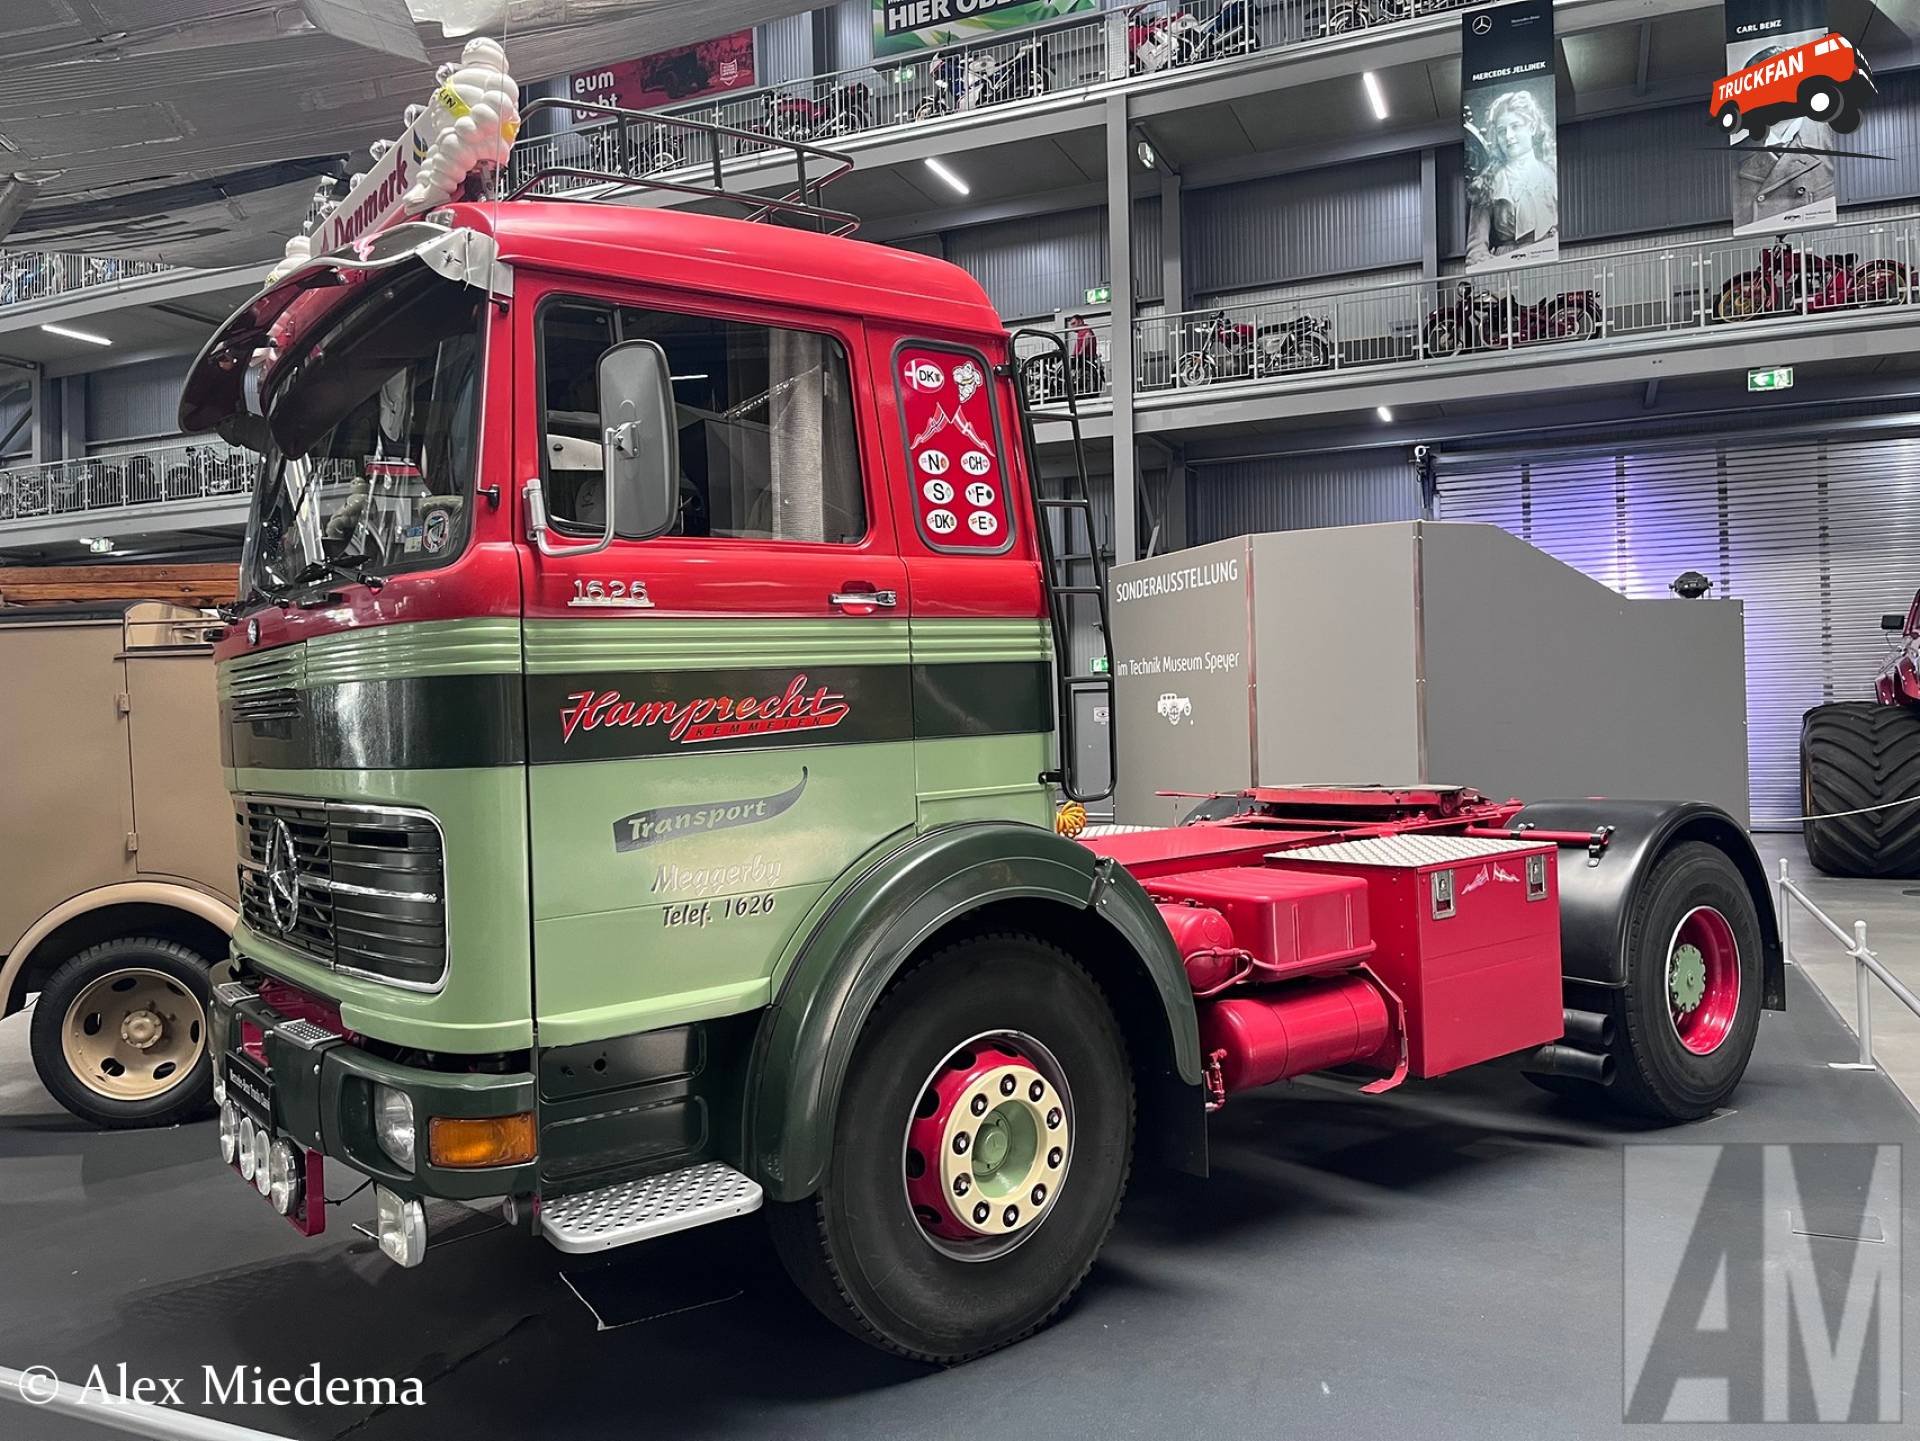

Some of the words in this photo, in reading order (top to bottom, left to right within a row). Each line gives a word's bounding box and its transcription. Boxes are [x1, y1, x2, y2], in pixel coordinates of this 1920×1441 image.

[888, 0, 951, 31] HIER
[1736, 25, 1758, 34] CARL
[1759, 19, 1782, 30] BENZ
[1472, 67, 1511, 81] MERCEDES
[1511, 61, 1546, 74] JELLINEK
[574, 71, 615, 94] eum
[334, 145, 408, 250] Danmark
[918, 370, 935, 382] DK
[928, 454, 940, 471] N
[968, 455, 984, 471] CH
[933, 483, 945, 501] S
[975, 486, 985, 504] F
[934, 514, 951, 529] DK
[978, 516, 988, 530] E
[573, 579, 648, 602] 1626
[1116, 559, 1238, 602] SONDERAUSSTELLUNG
[1117, 661, 1128, 676] im
[1129, 656, 1161, 676] Technik
[1162, 654, 1203, 673] Museum
[1204, 651, 1240, 674] Speyer
[559, 672, 850, 744] Hamprecht
[694, 716, 824, 737] KEMMETEN
[627, 799, 768, 842] Transport
[650, 854, 782, 896] Meggerby
[662, 900, 713, 929] Telef.
[723, 893, 776, 919] 1626
